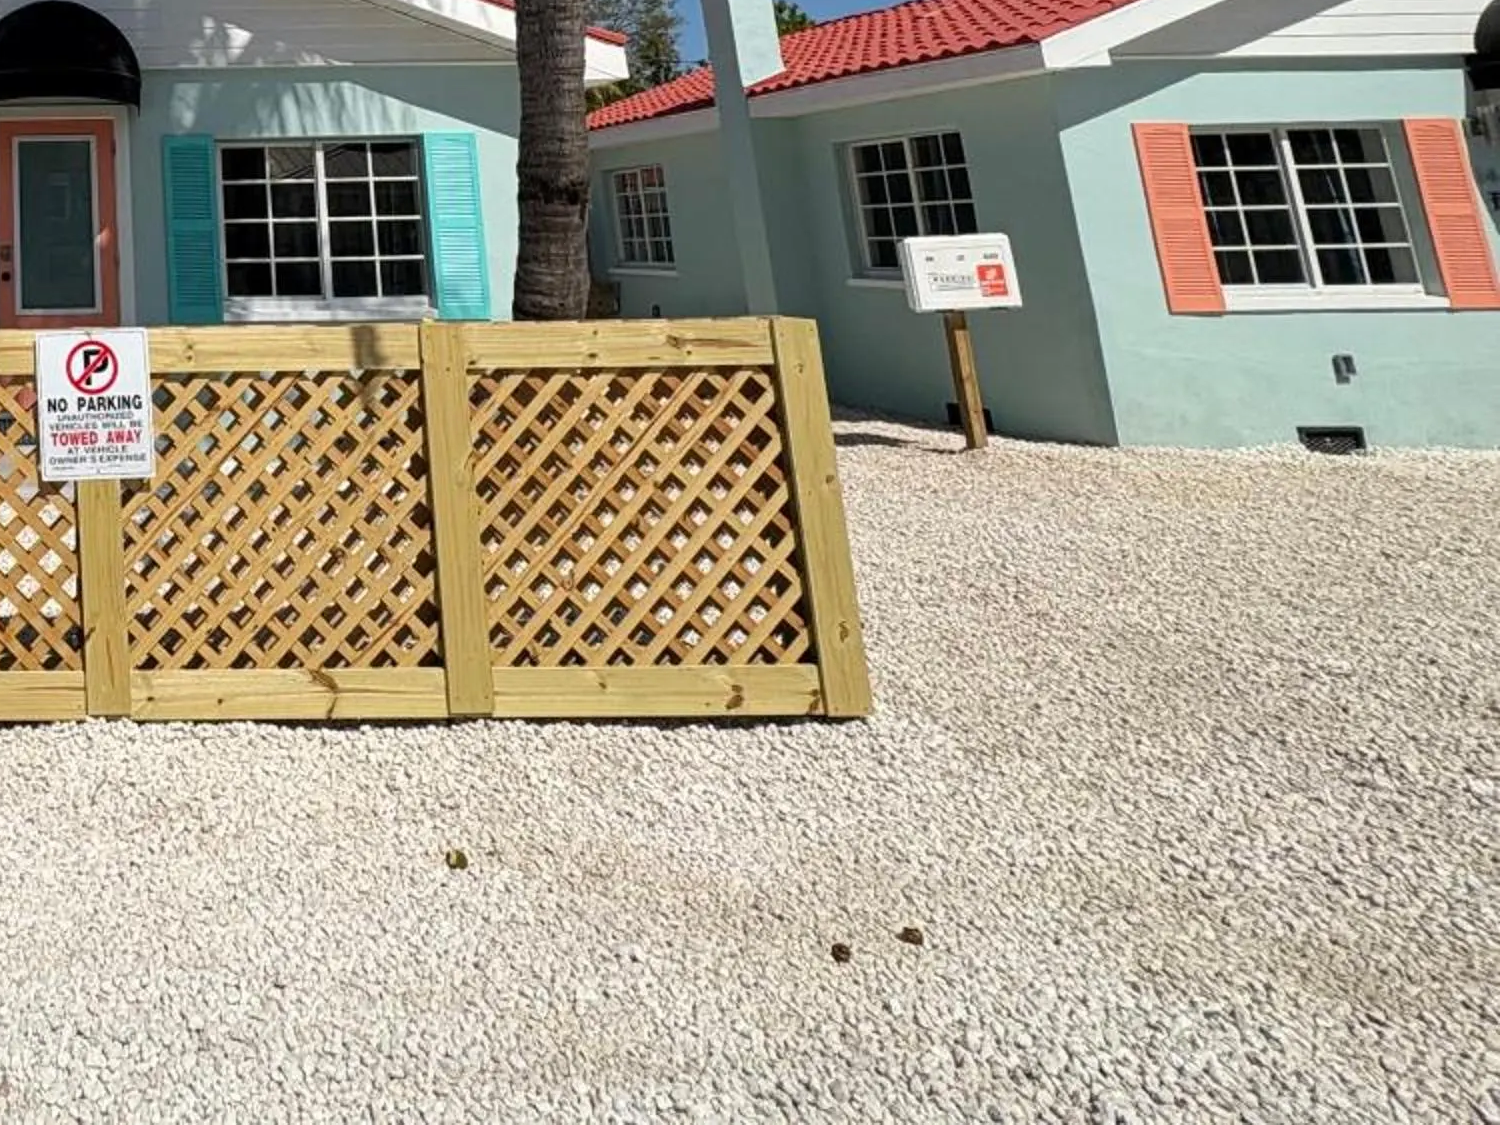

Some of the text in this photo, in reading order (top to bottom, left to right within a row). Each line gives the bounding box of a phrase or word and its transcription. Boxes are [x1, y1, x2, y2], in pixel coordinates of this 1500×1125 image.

[47, 394, 143, 413] NO PARKING
[57, 411, 134, 422] UNAUTHORIZED
[49, 420, 143, 431] VEHICLES WILL BE
[51, 429, 142, 447] TOWED AWAY
[67, 445, 128, 455] AT VEHICLE
[99, 453, 147, 464] EXPENSE
